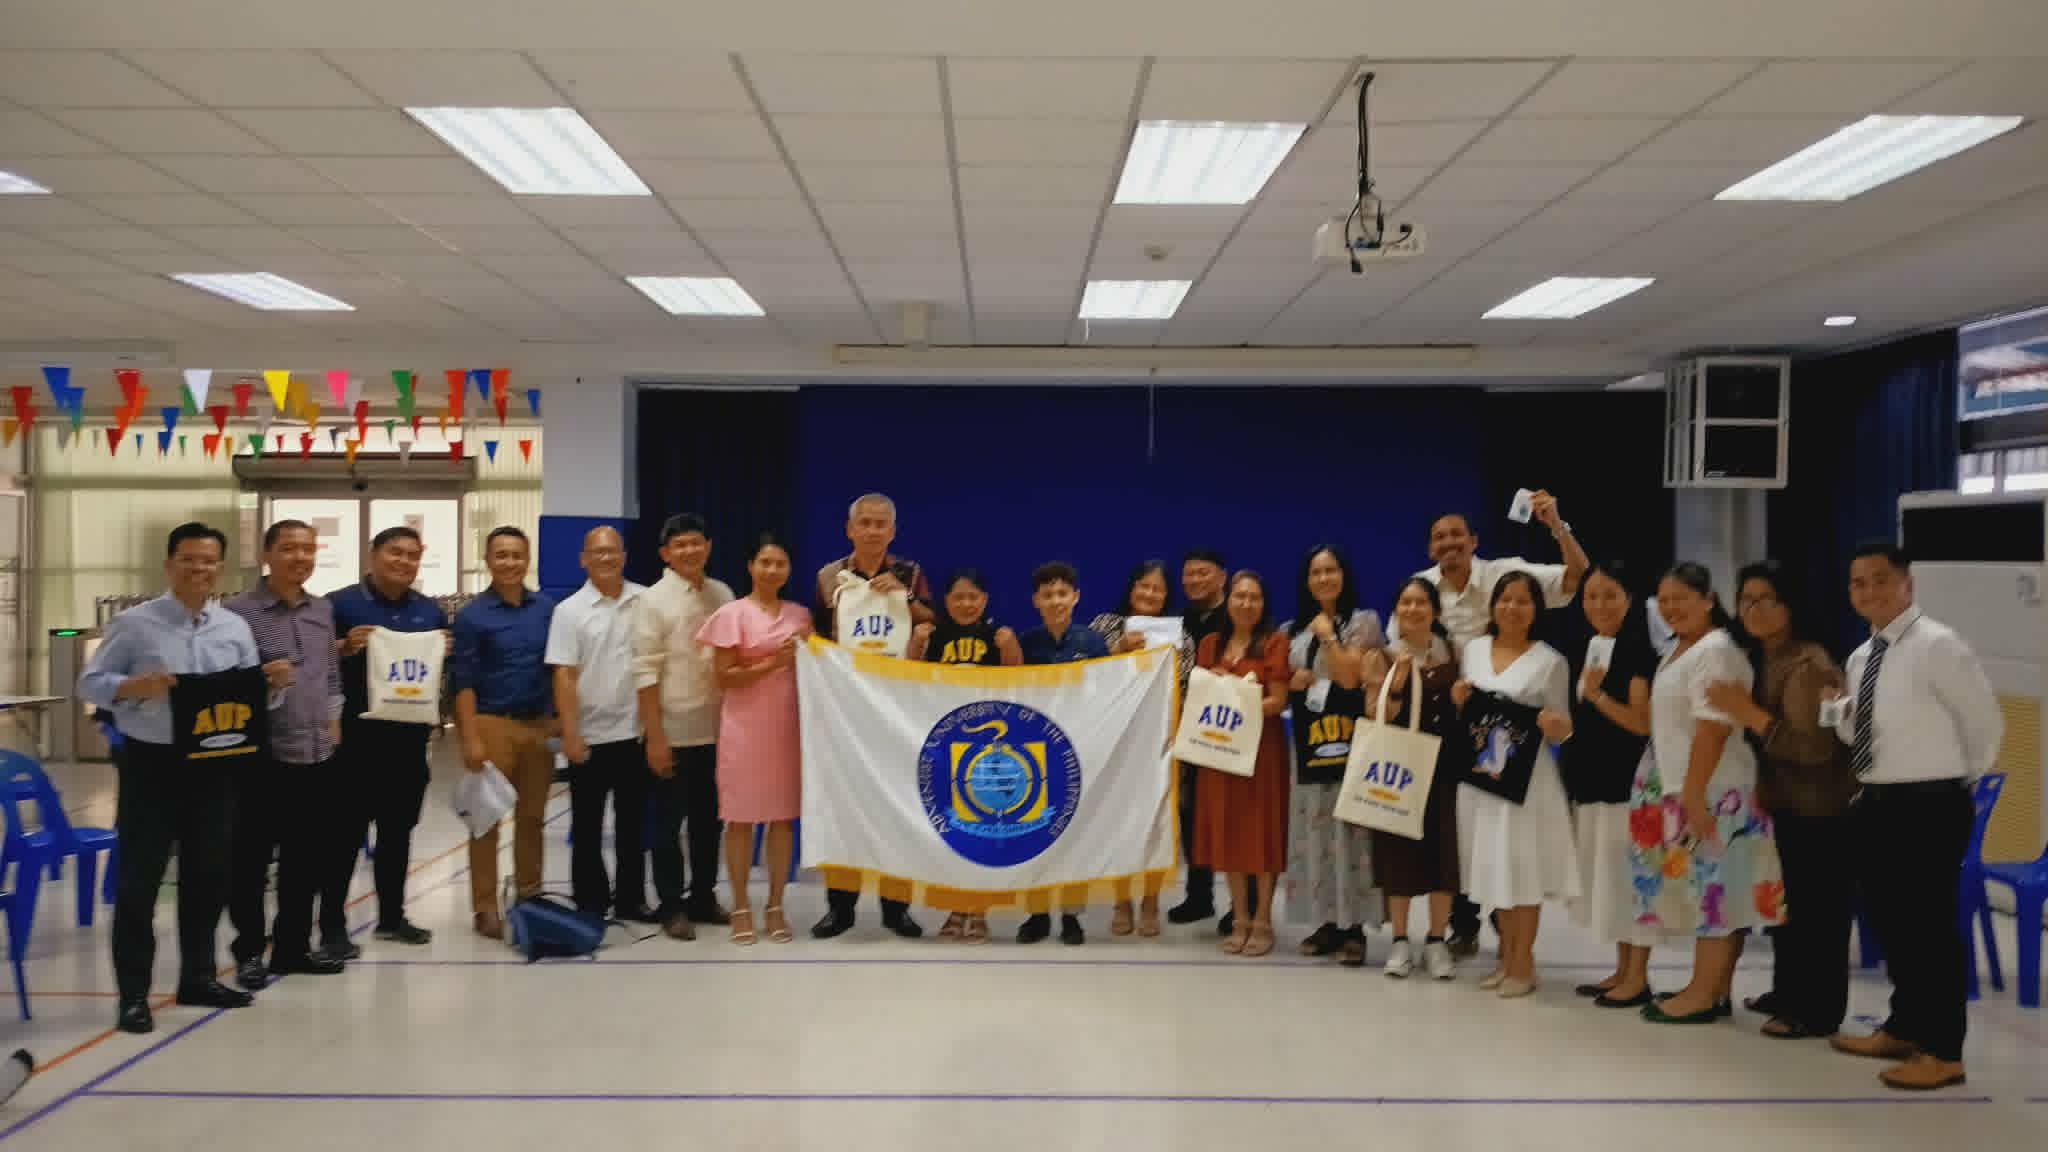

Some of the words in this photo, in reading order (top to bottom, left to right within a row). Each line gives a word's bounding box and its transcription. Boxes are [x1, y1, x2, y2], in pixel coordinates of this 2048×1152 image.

[853, 615, 895, 637] AUP
[942, 637, 988, 663] AUP
[387, 659, 429, 683] AUP
[192, 702, 252, 735] AUP
[1018, 708, 1036, 722] OF
[1042, 723, 1066, 745] THE
[1198, 704, 1243, 731] AUP
[1364, 761, 1413, 790] AUP
